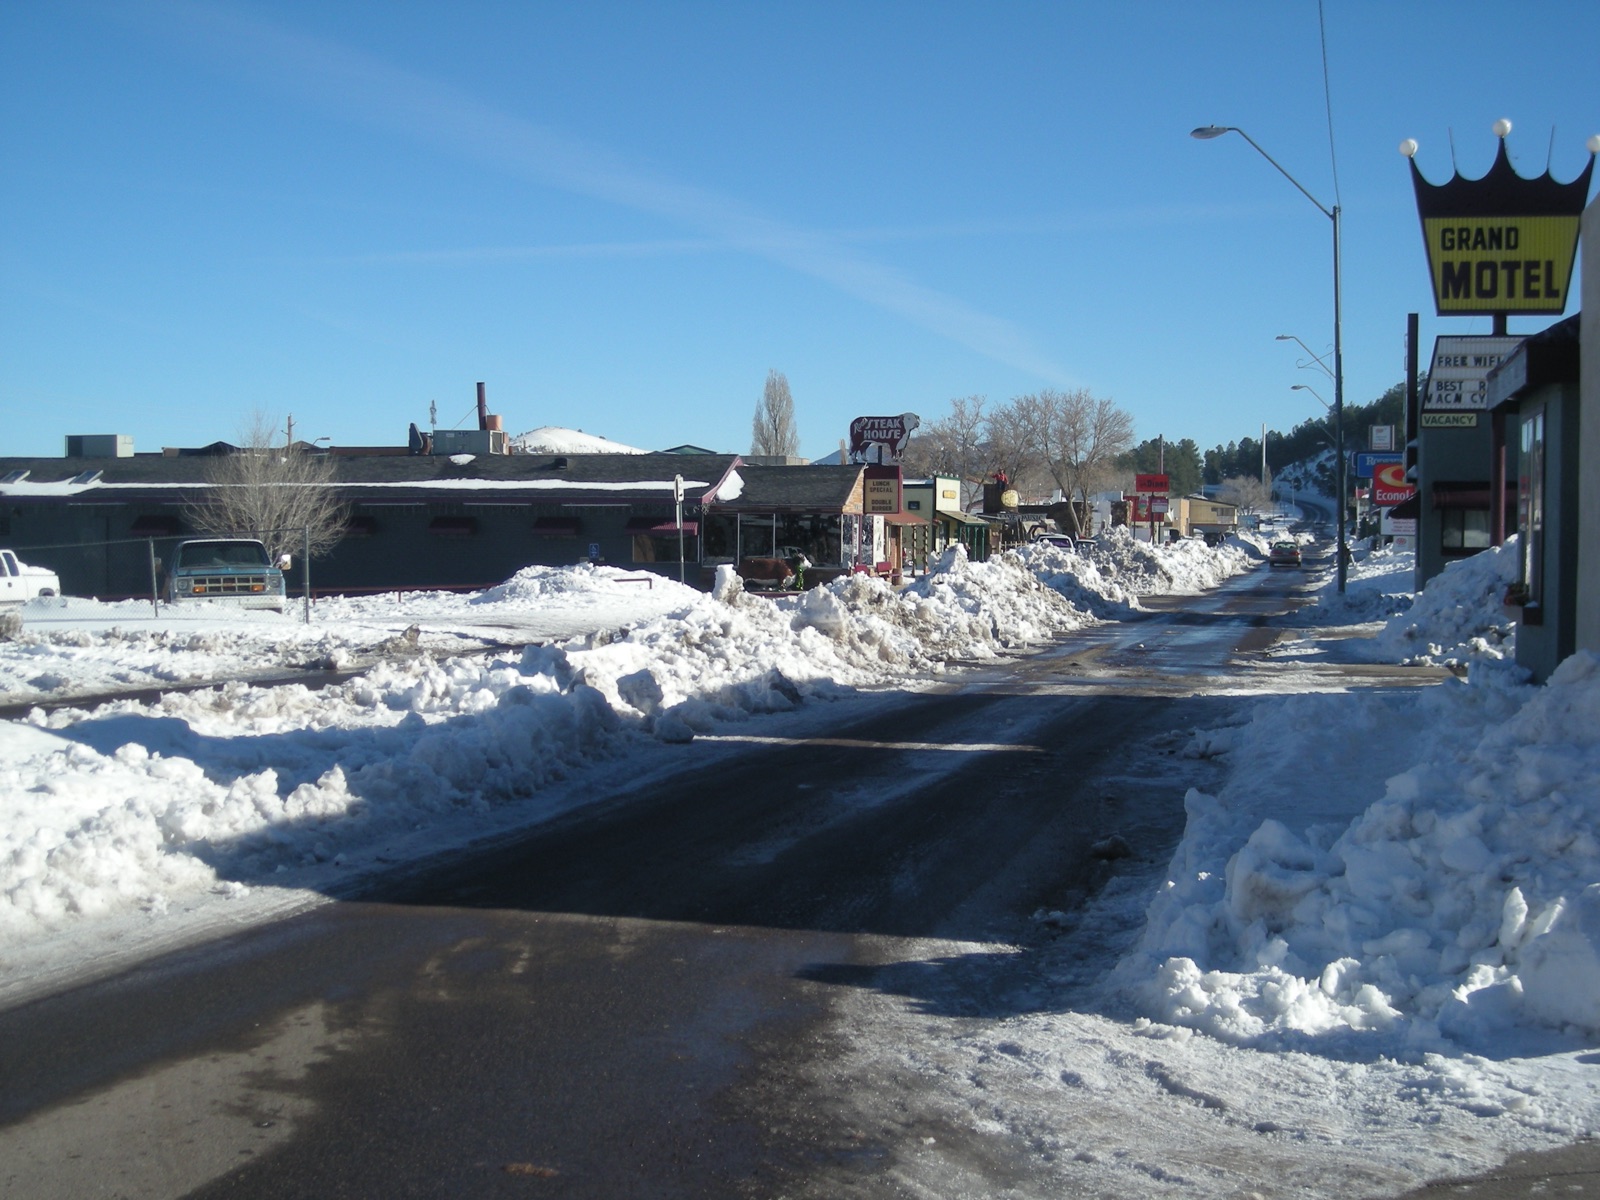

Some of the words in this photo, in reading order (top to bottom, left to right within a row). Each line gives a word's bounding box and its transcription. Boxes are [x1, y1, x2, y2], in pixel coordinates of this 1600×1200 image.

[1441, 226, 1519, 251] GRAND
[1441, 259, 1560, 299] MOTEL
[1437, 356, 1468, 367] FREE
[1436, 381, 1464, 391] BEST
[865, 418, 902, 430] STEAK
[1423, 415, 1474, 425] VACANCY
[863, 429, 901, 440] HOUSE
